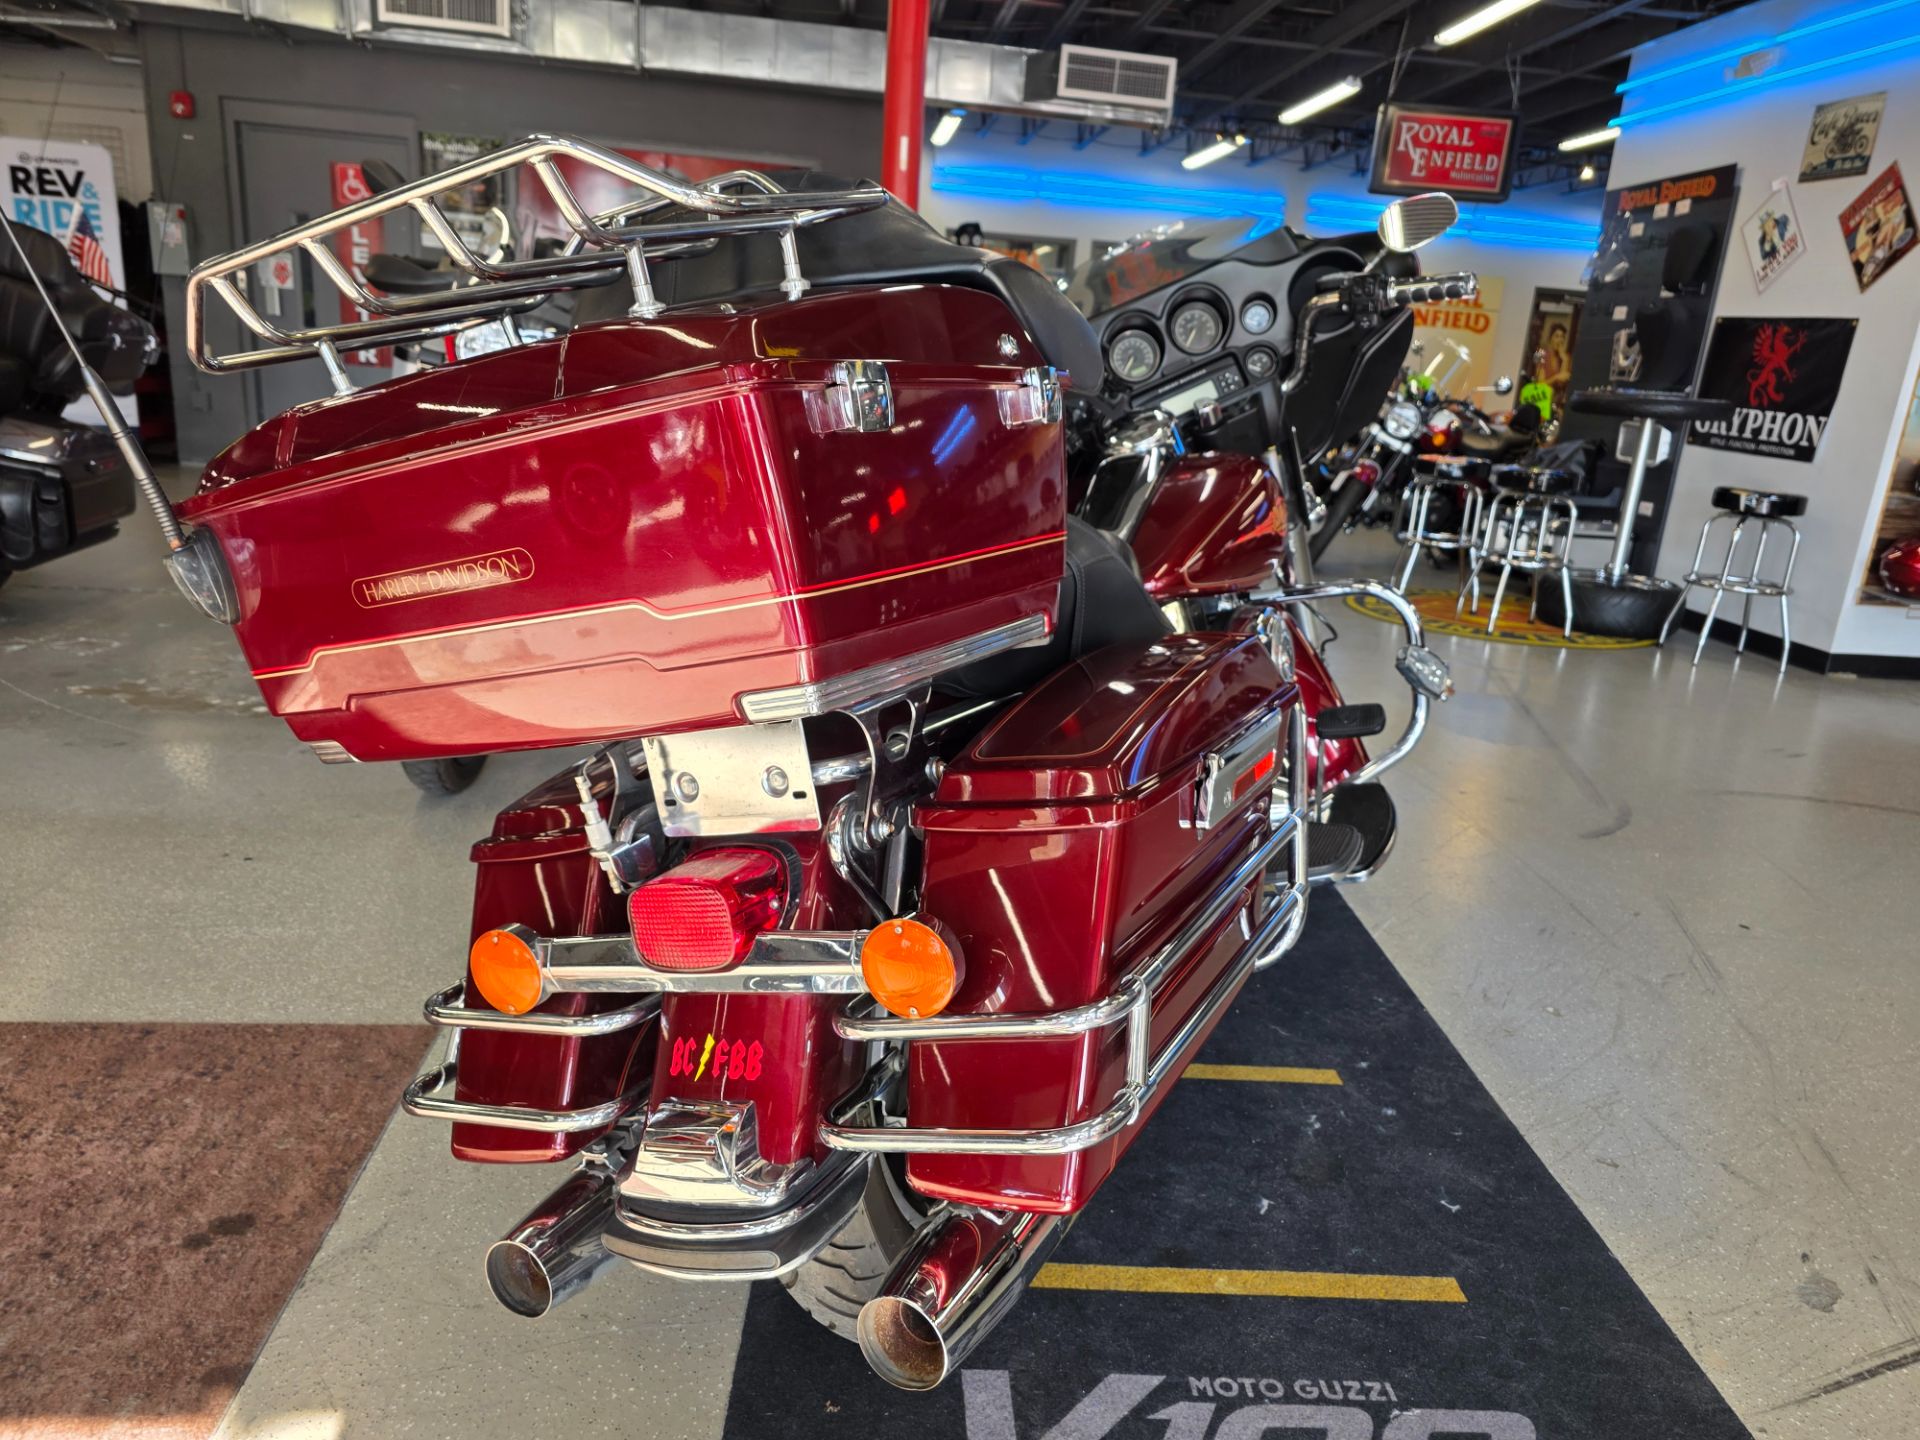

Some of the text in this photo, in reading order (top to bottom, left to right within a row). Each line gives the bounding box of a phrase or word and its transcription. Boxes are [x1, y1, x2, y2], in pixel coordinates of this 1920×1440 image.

[1397, 121, 1475, 160] ROYAL
[1411, 147, 1499, 177] ENFIELD
[9, 165, 98, 200] REV &
[1619, 175, 1716, 211] ROYAL ENFIELD
[13, 196, 102, 234] RIDE
[1414, 308, 1490, 335] NFIELD
[362, 554, 521, 603] HARLEY-DAVIDSON
[1189, 1376, 1398, 1402] MOTO GUZZI
